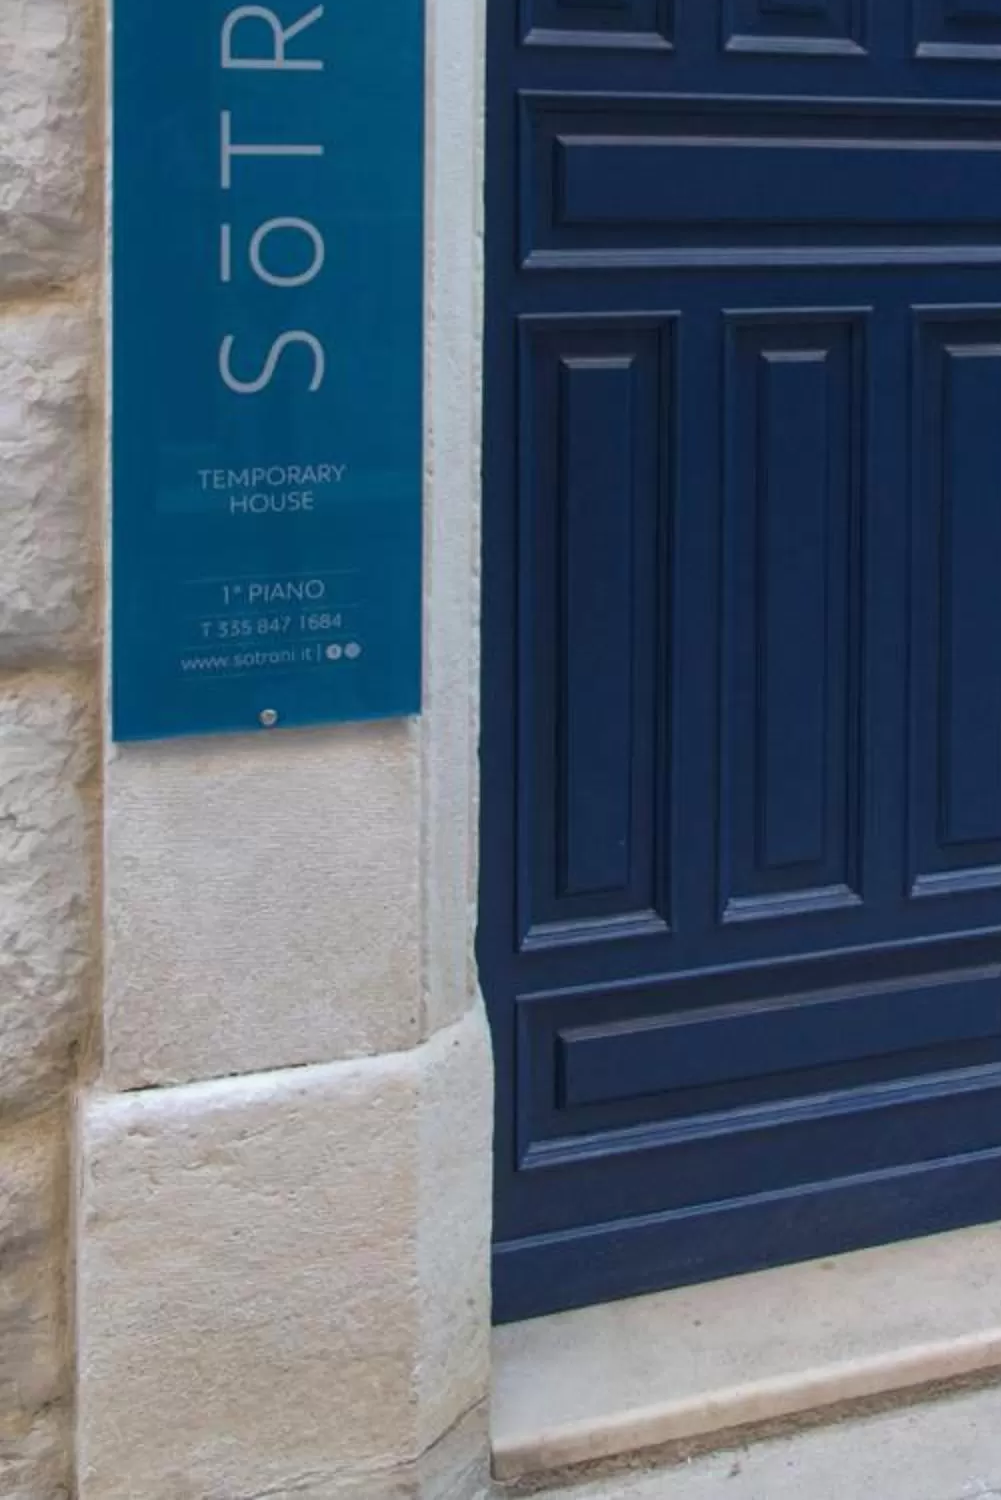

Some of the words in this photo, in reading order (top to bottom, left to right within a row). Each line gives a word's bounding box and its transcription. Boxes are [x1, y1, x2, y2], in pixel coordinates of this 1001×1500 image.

[199, 465, 345, 489] TEMPORARY
[231, 491, 314, 513] HOUSE
[248, 579, 325, 604] PIANO
[200, 621, 212, 638] T
[217, 619, 252, 638] 335
[257, 616, 291, 634] 847
[299, 612, 342, 631] 1684
